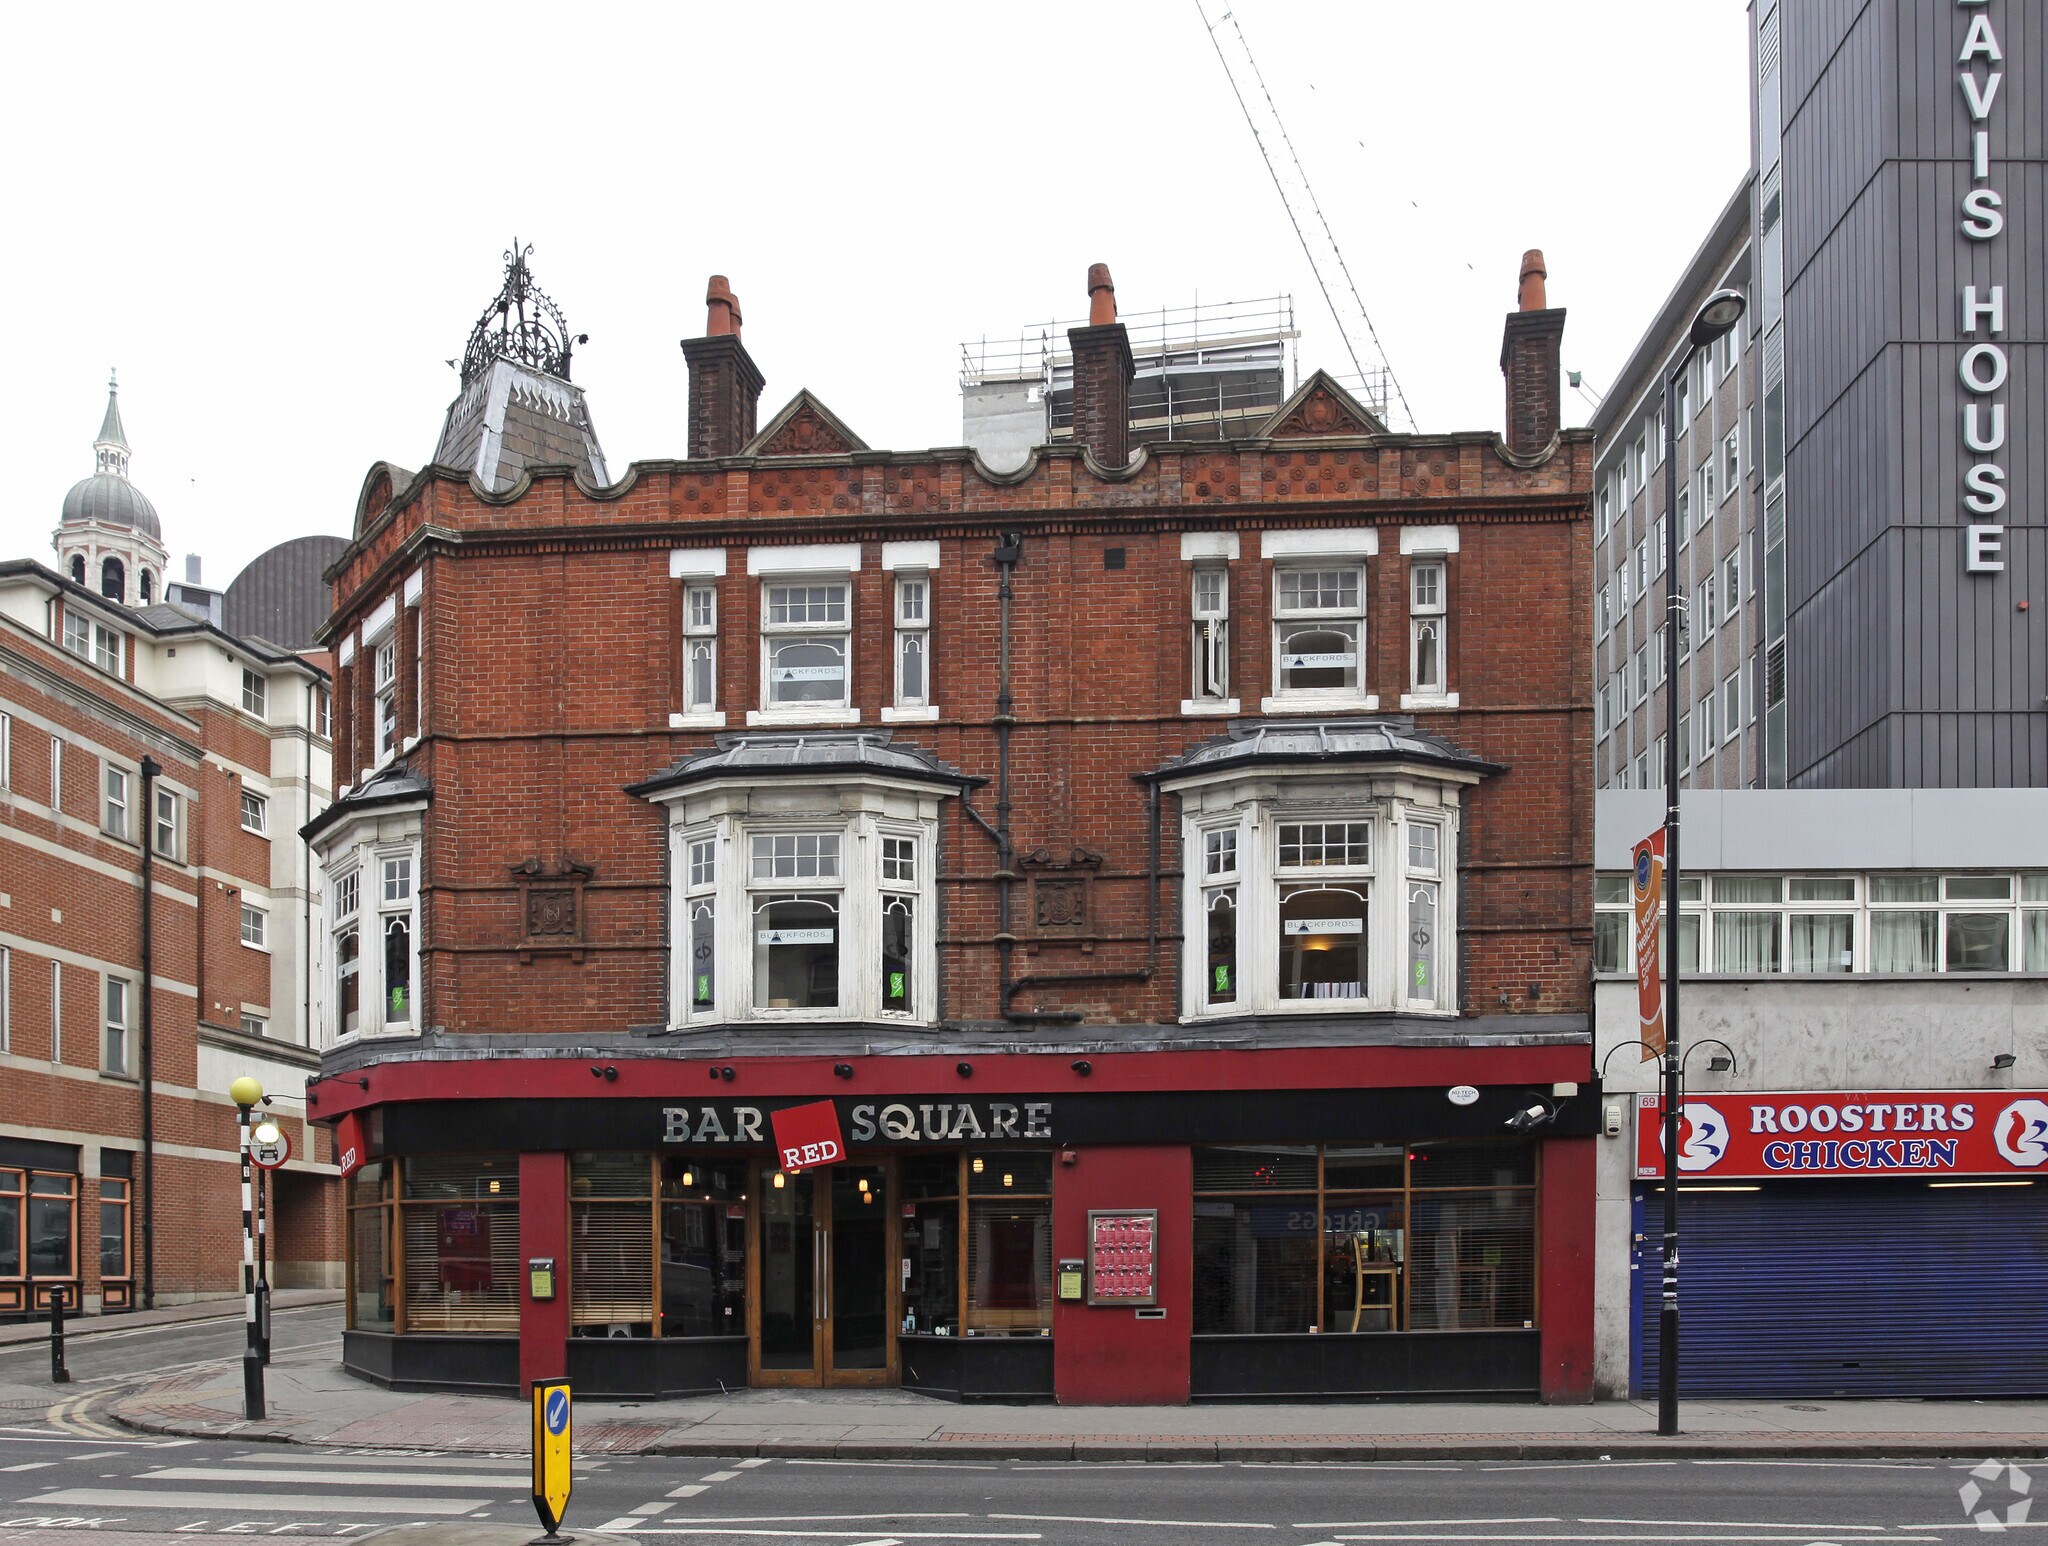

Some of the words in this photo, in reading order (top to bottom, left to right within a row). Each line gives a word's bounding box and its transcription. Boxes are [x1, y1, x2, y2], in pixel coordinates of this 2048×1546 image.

[1957, 0, 2004, 241] AVIS
[1960, 285, 2009, 574] HOUSE
[1282, 654, 1349, 667] BLACKFORDS
[772, 667, 837, 679] BLACKFORDS
[1287, 920, 1355, 933] BLACKFORDS
[760, 931, 826, 943] BLACKFORDS
[1642, 1097, 1656, 1107] 69
[1749, 1103, 1975, 1134] ROOSTERS
[662, 1107, 764, 1143] BAR
[783, 1140, 838, 1168] RED
[852, 1103, 1051, 1142] SQUARE
[341, 1147, 356, 1173] RED
[1762, 1138, 1959, 1170] CHICKEN
[174, 1520, 382, 1535] LEFT
